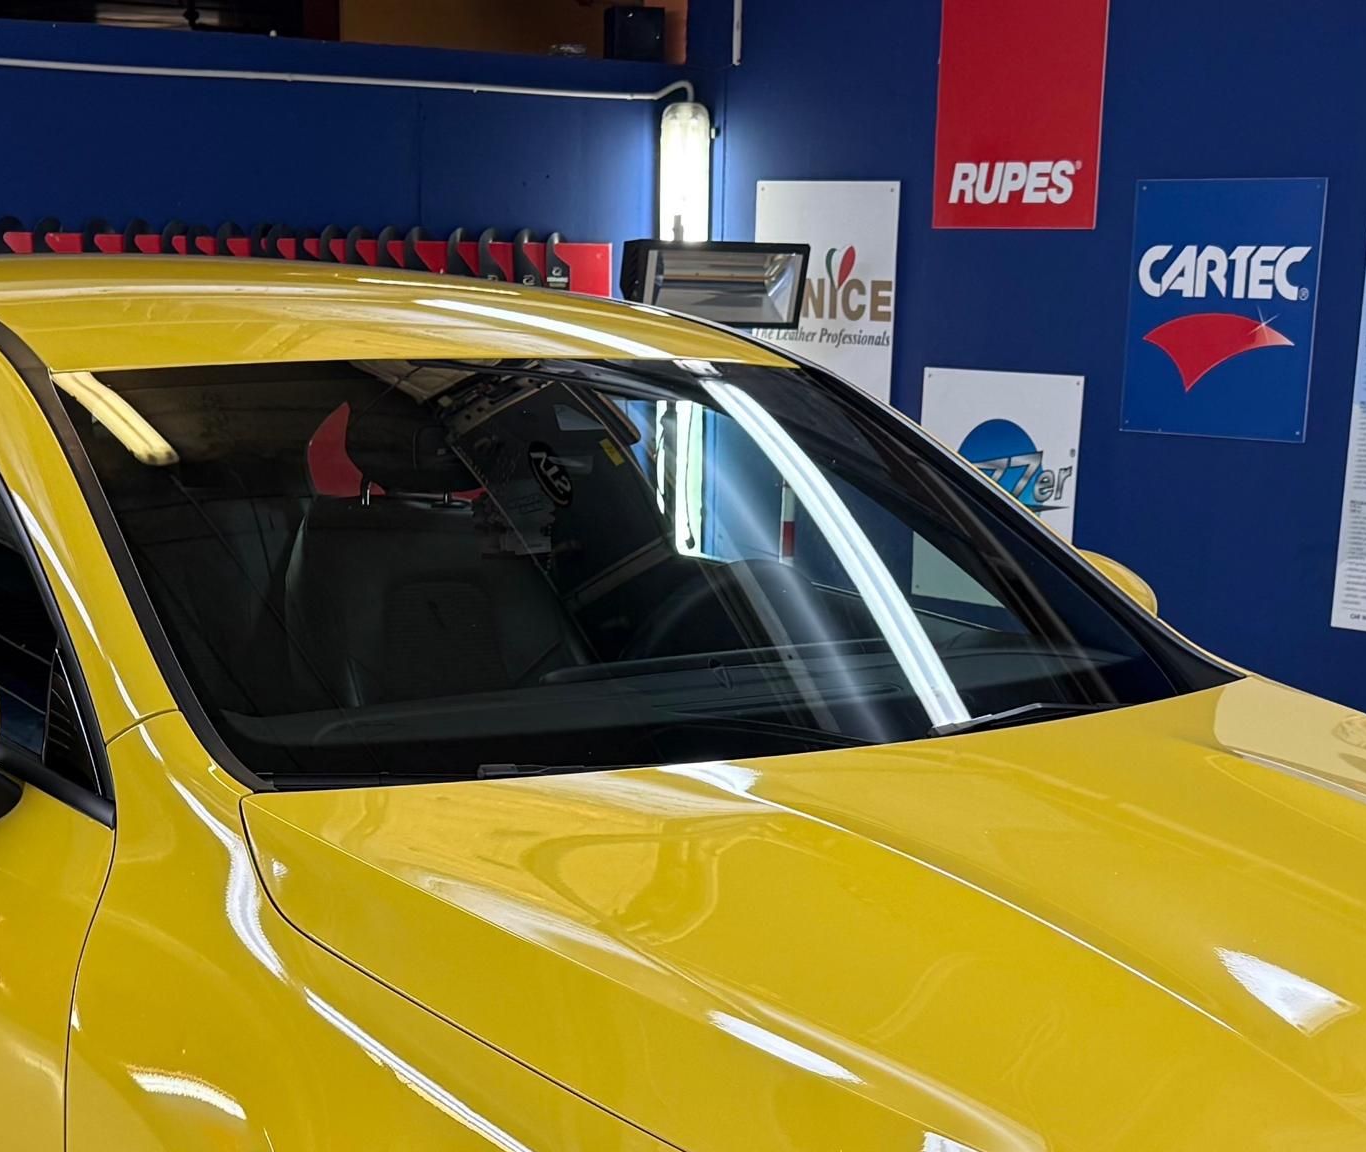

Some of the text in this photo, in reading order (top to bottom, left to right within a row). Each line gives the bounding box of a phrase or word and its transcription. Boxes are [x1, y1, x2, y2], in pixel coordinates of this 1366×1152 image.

[948, 160, 1076, 205] RUPES
[1138, 244, 1312, 301] CARTEC
[776, 327, 816, 342] Leather
[818, 328, 890, 348] Professionals
